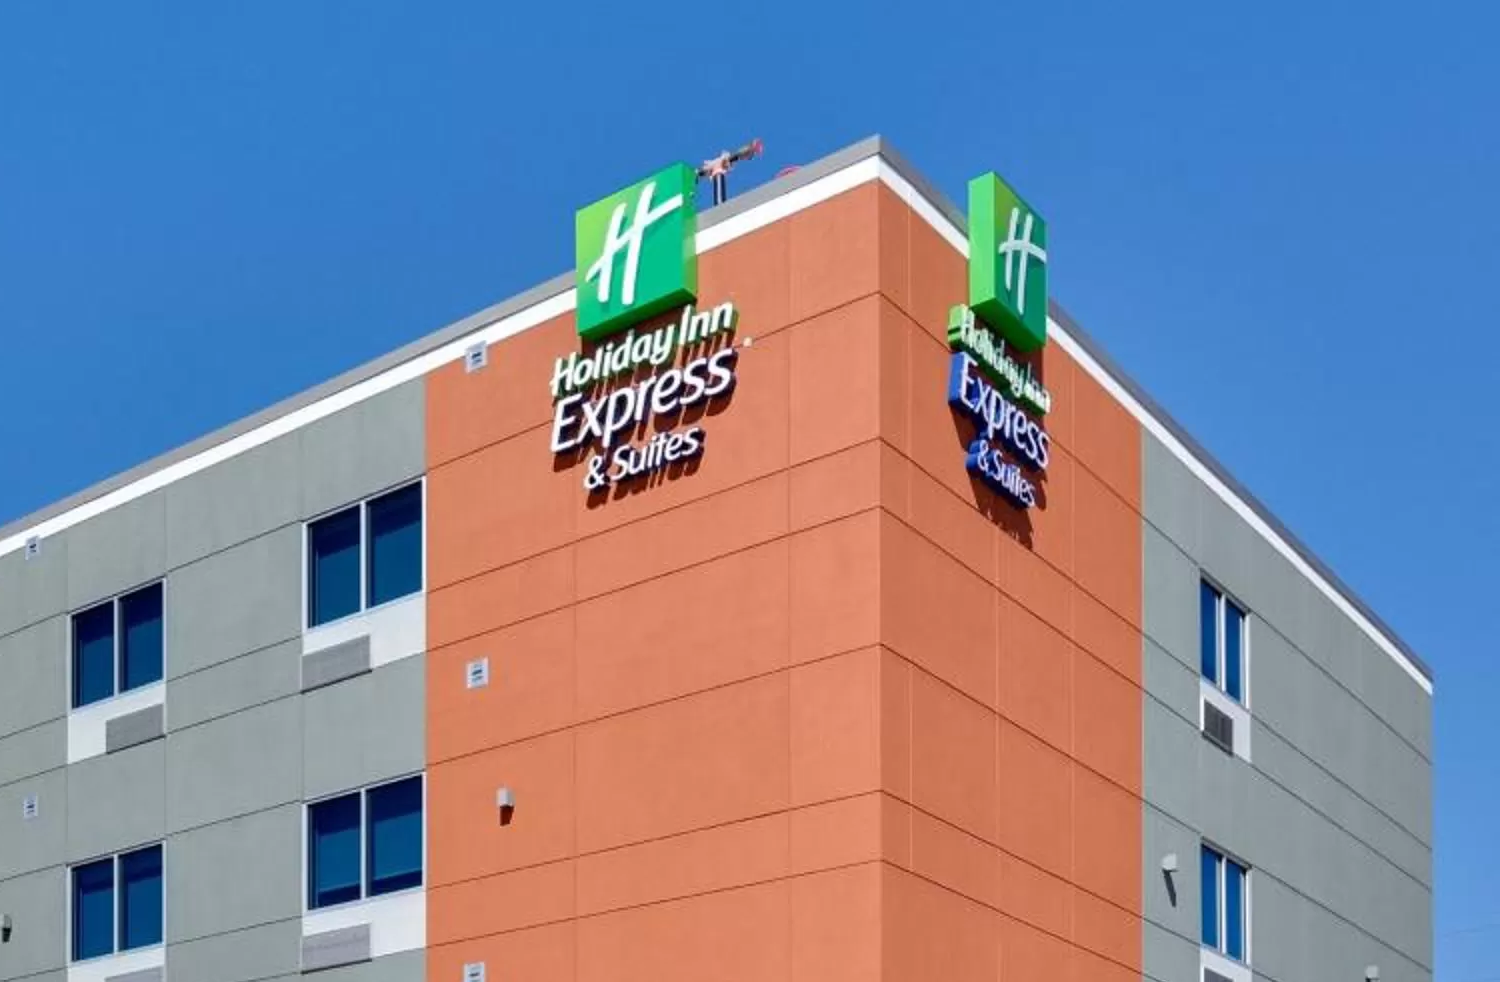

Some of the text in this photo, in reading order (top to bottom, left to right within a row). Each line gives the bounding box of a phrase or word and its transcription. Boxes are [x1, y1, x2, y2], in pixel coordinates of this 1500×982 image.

[550, 301, 733, 397] Holiday Inn
[551, 348, 734, 452] Express
[961, 351, 1050, 470] Express
[584, 427, 700, 489] & Suites
[977, 439, 1036, 507] & Suites
